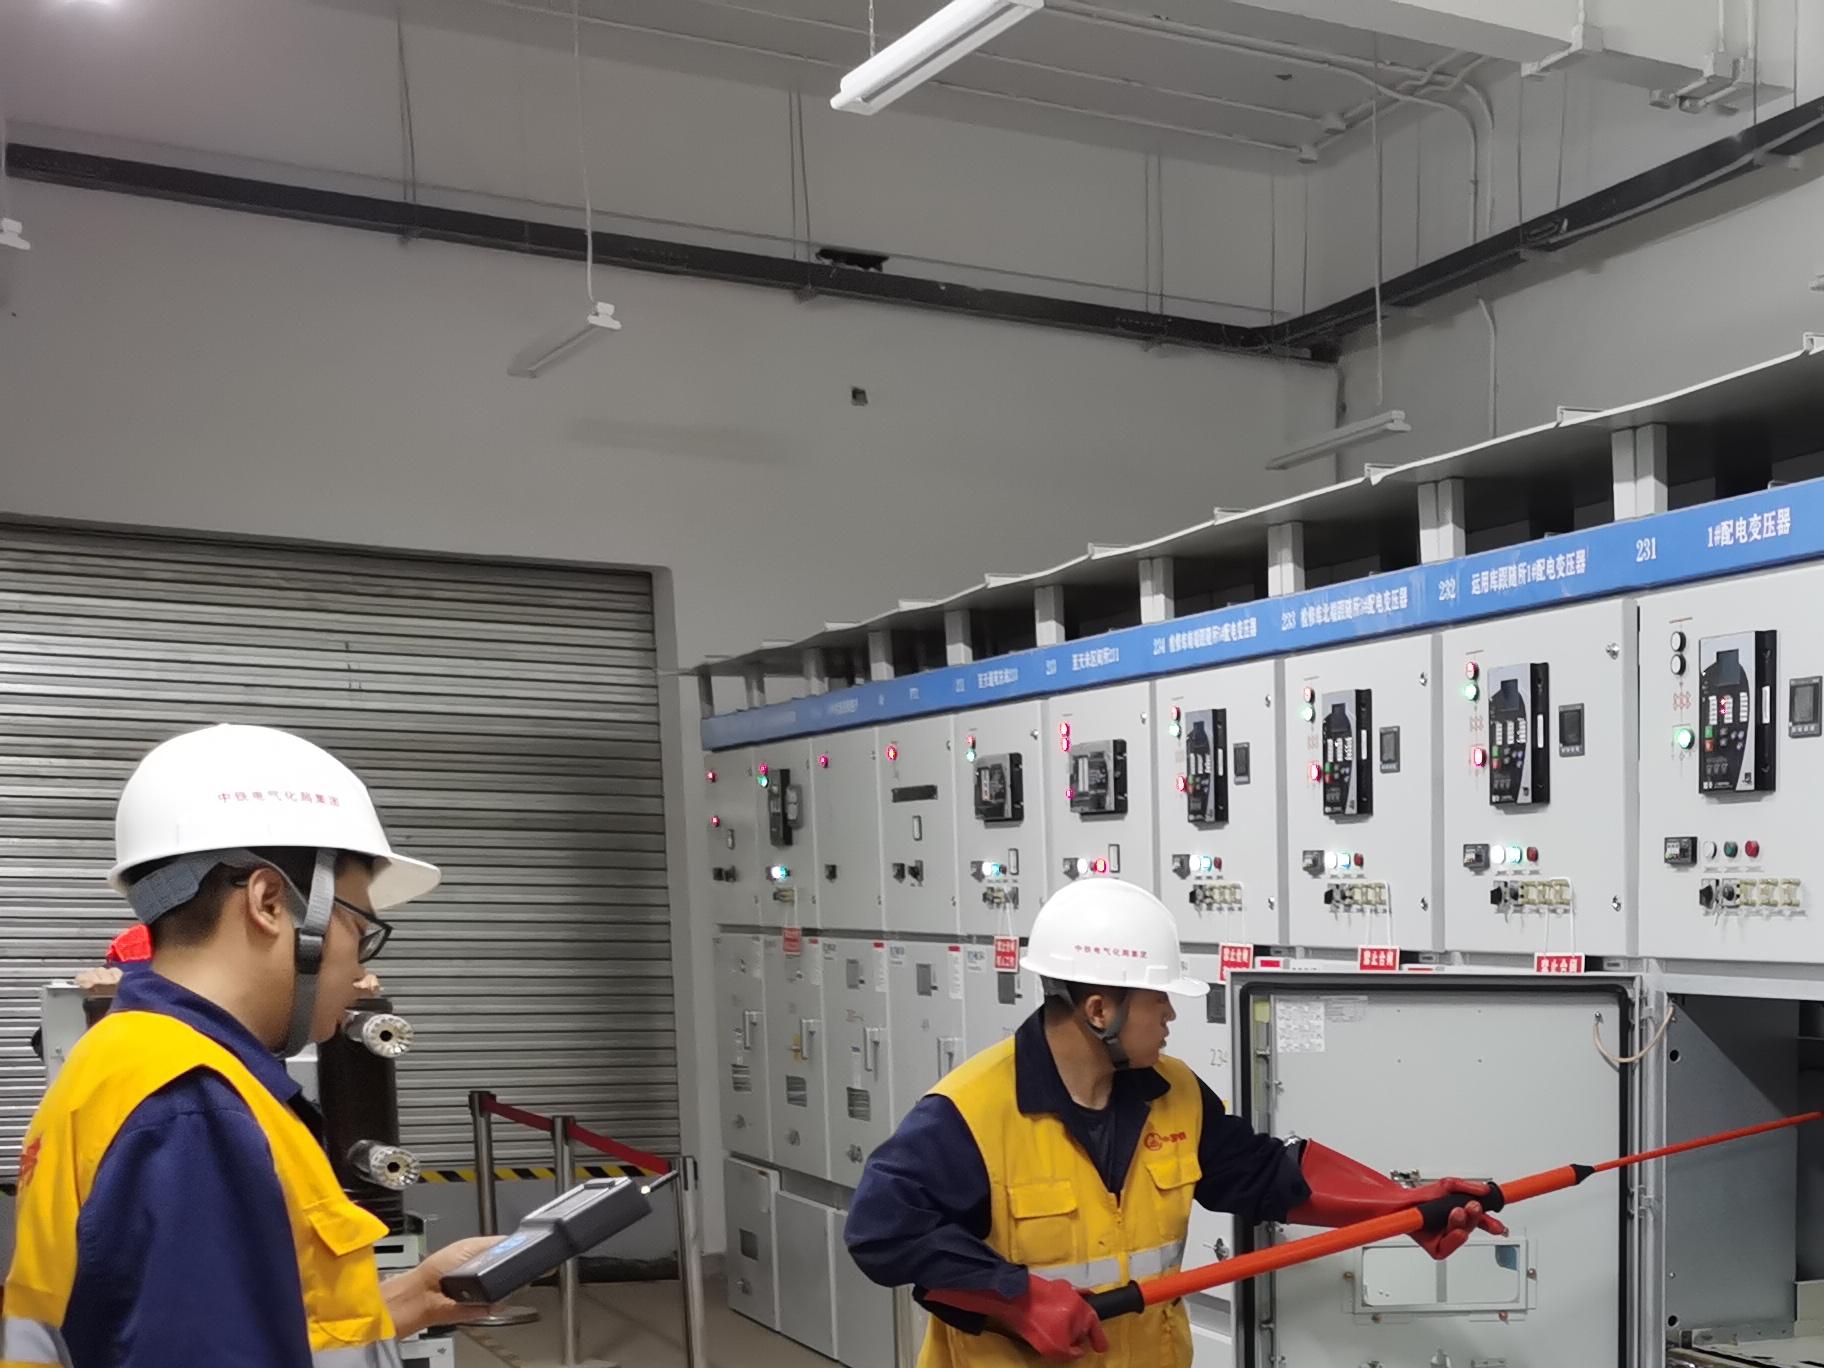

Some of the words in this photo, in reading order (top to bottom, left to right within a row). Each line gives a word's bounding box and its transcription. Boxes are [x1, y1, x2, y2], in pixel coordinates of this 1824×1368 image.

[1636, 537, 1657, 562] 231
[1706, 505, 1792, 548] 1#配电变压器
